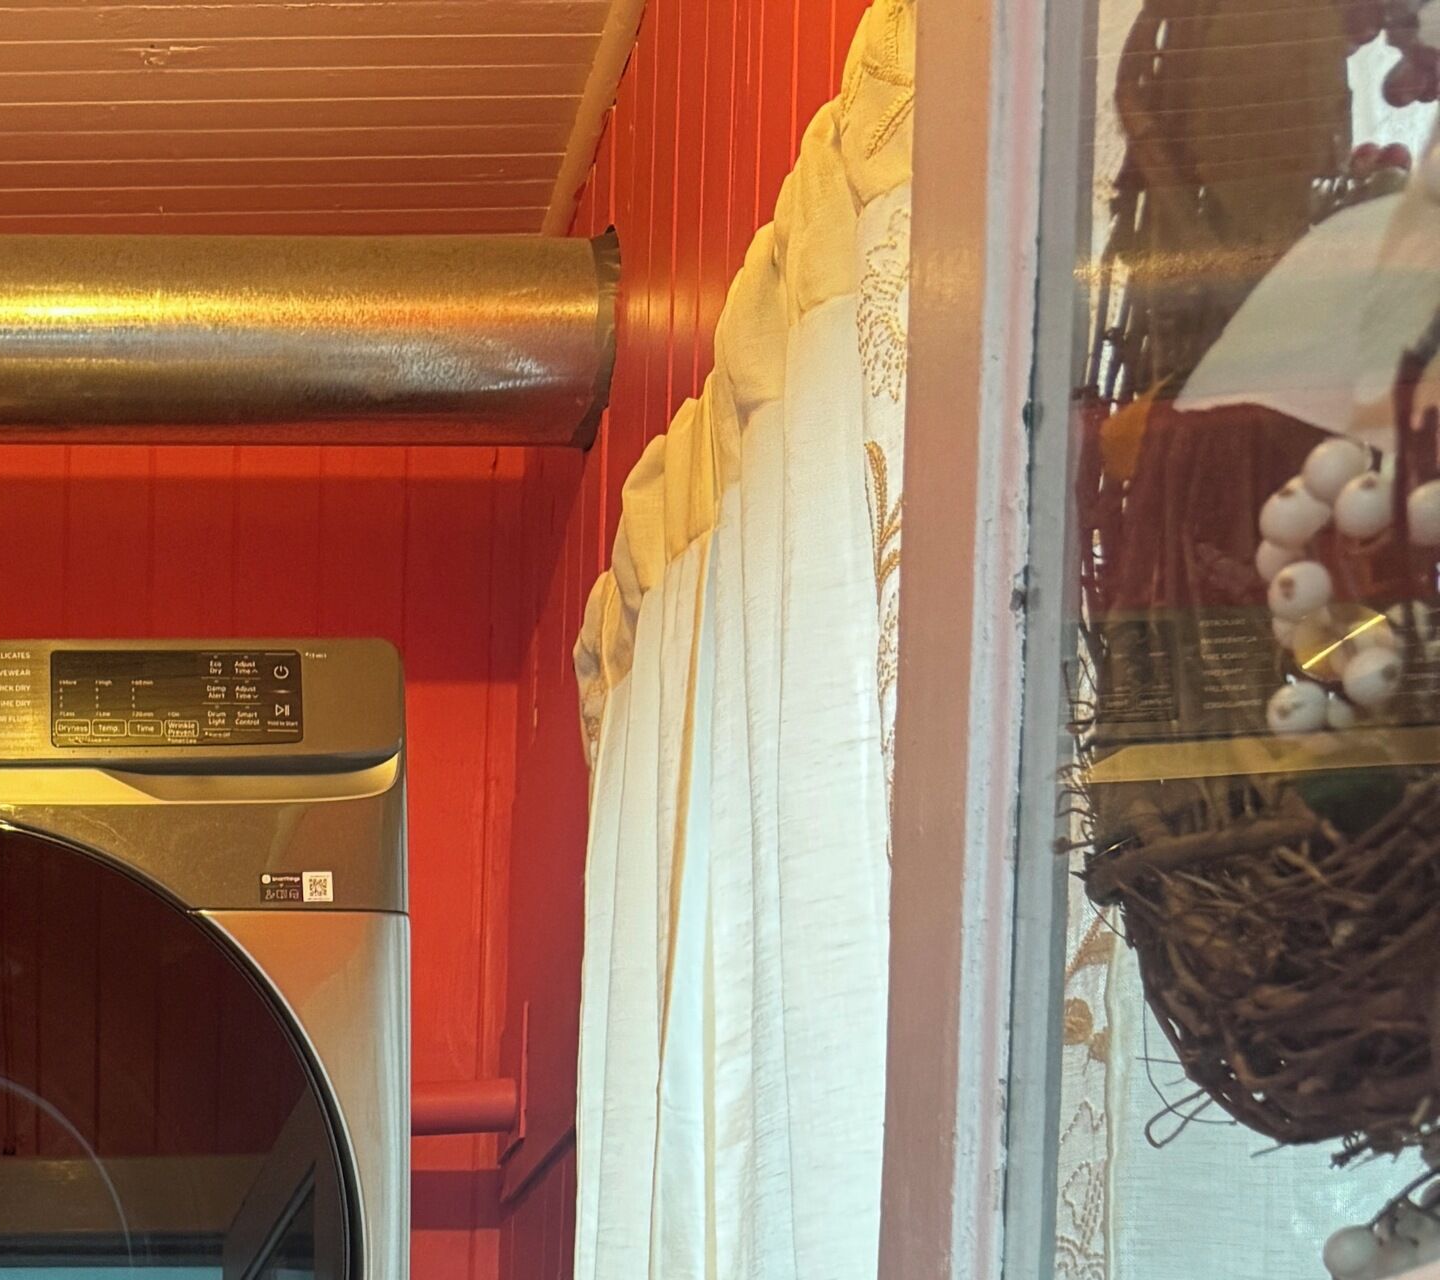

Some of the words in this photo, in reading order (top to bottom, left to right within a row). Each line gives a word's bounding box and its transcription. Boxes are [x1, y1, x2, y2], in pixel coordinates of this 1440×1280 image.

[234, 661, 256, 669] Adjust
[15, 684, 31, 692] DRY
[234, 686, 257, 694] Adjust
[58, 724, 88, 734] Dryness
